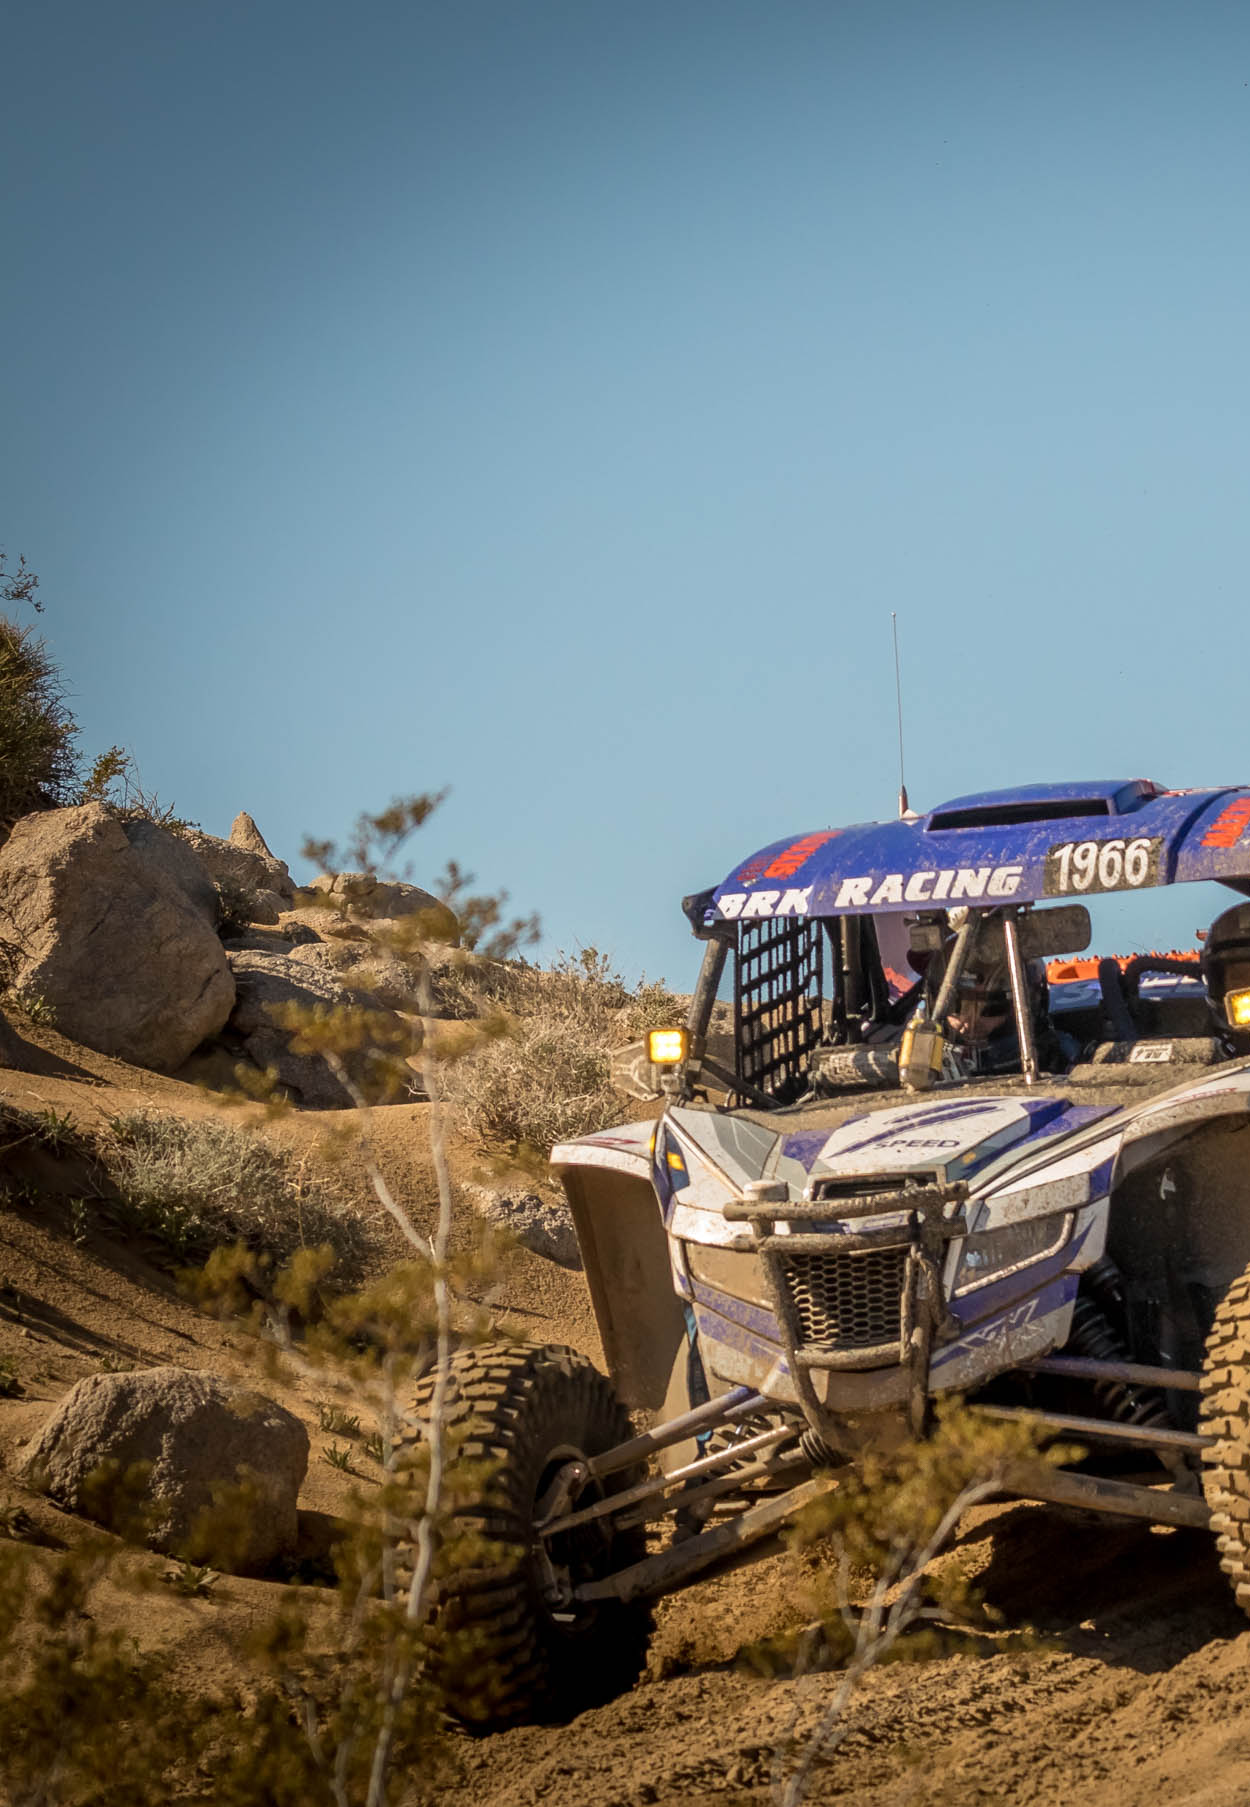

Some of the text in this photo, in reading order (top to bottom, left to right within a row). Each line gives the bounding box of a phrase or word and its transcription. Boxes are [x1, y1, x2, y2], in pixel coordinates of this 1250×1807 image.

[1051, 838, 1152, 891] 1966
[716, 866, 1023, 919] BRK RACING
[874, 1139, 961, 1149] SPEED
